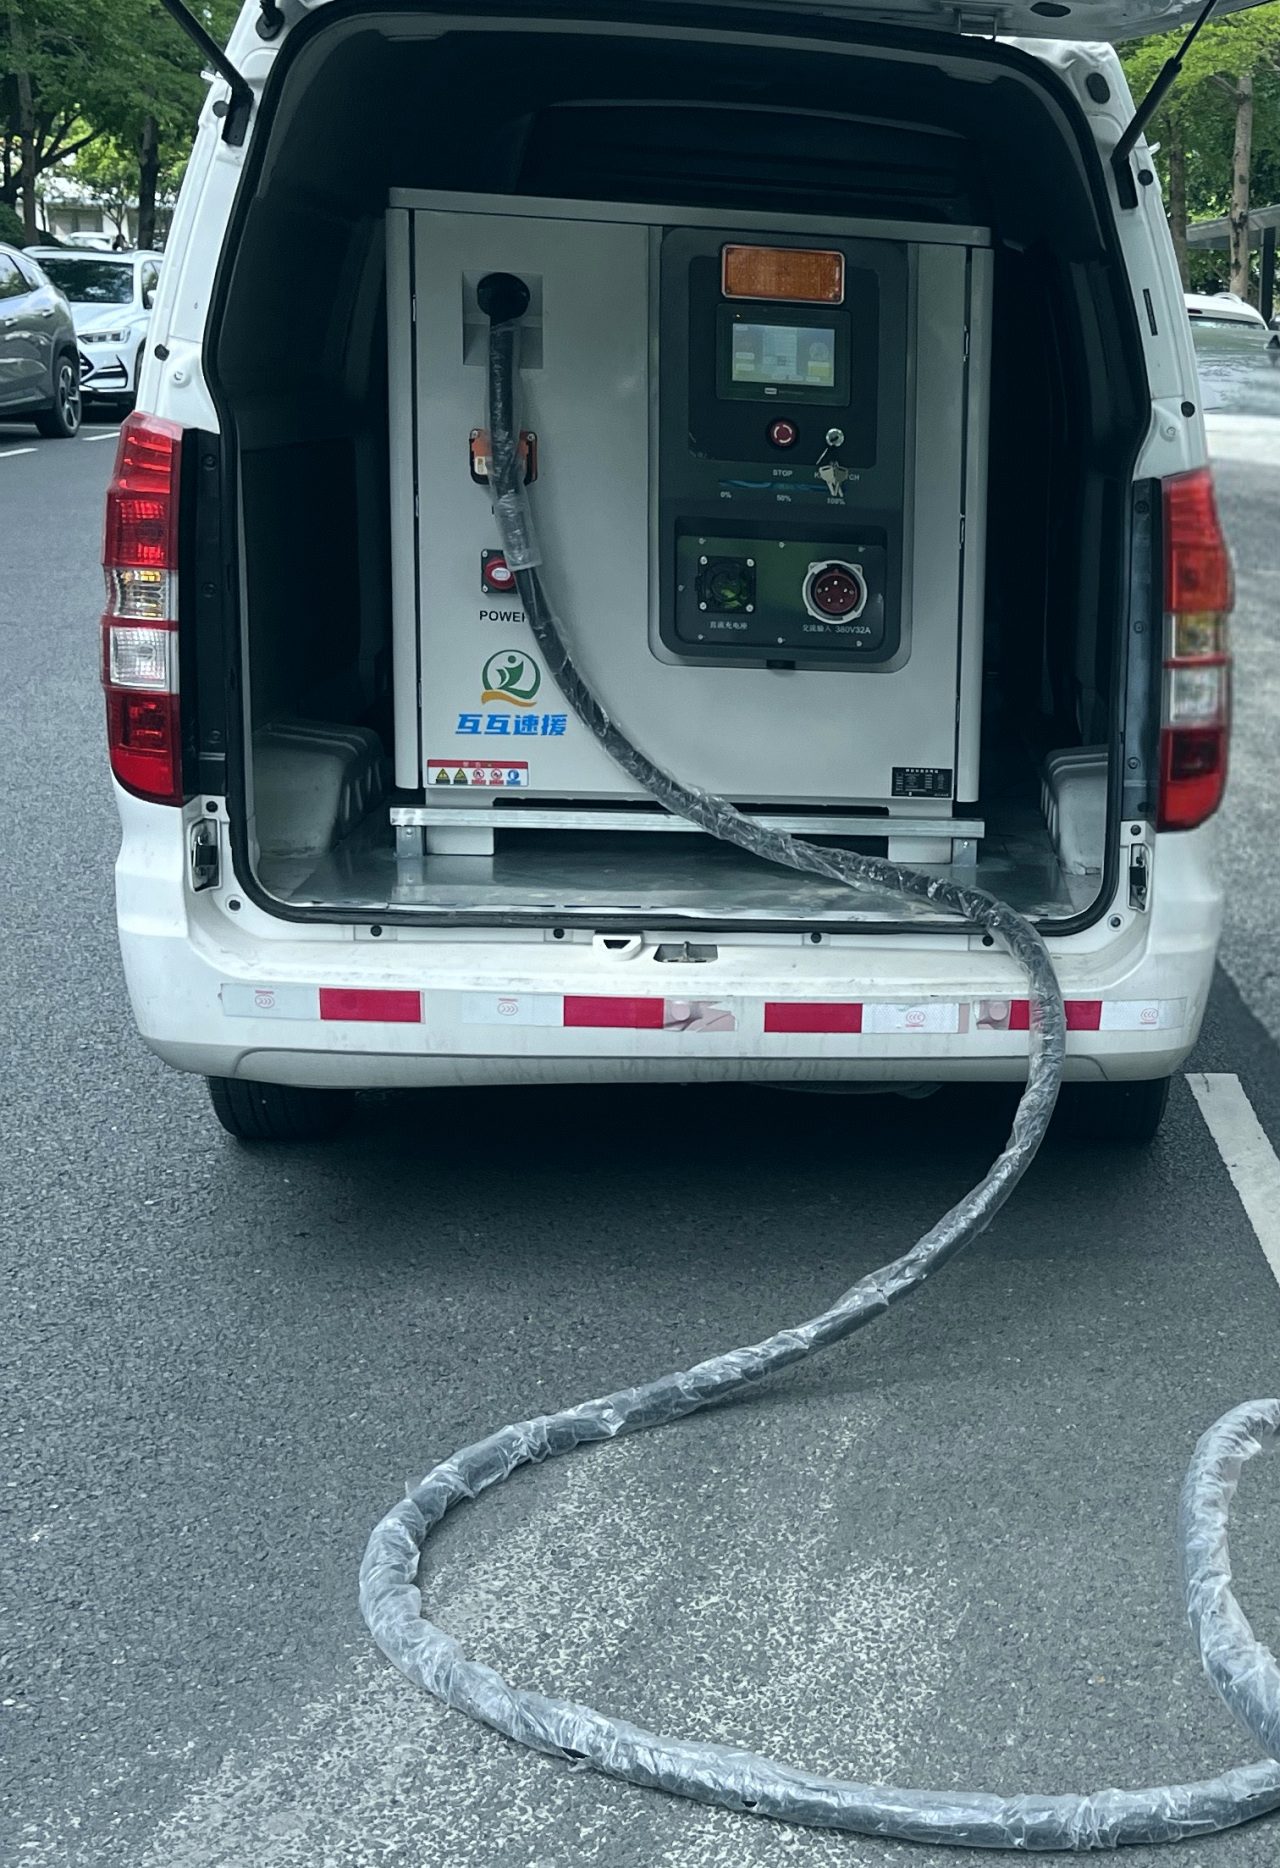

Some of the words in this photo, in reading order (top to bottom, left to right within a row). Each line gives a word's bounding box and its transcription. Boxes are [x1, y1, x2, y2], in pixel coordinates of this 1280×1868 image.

[772, 469, 793, 477] STOP
[720, 491, 732, 499] 0%
[776, 494, 792, 503] 50%
[455, 713, 568, 736] 互互速援
